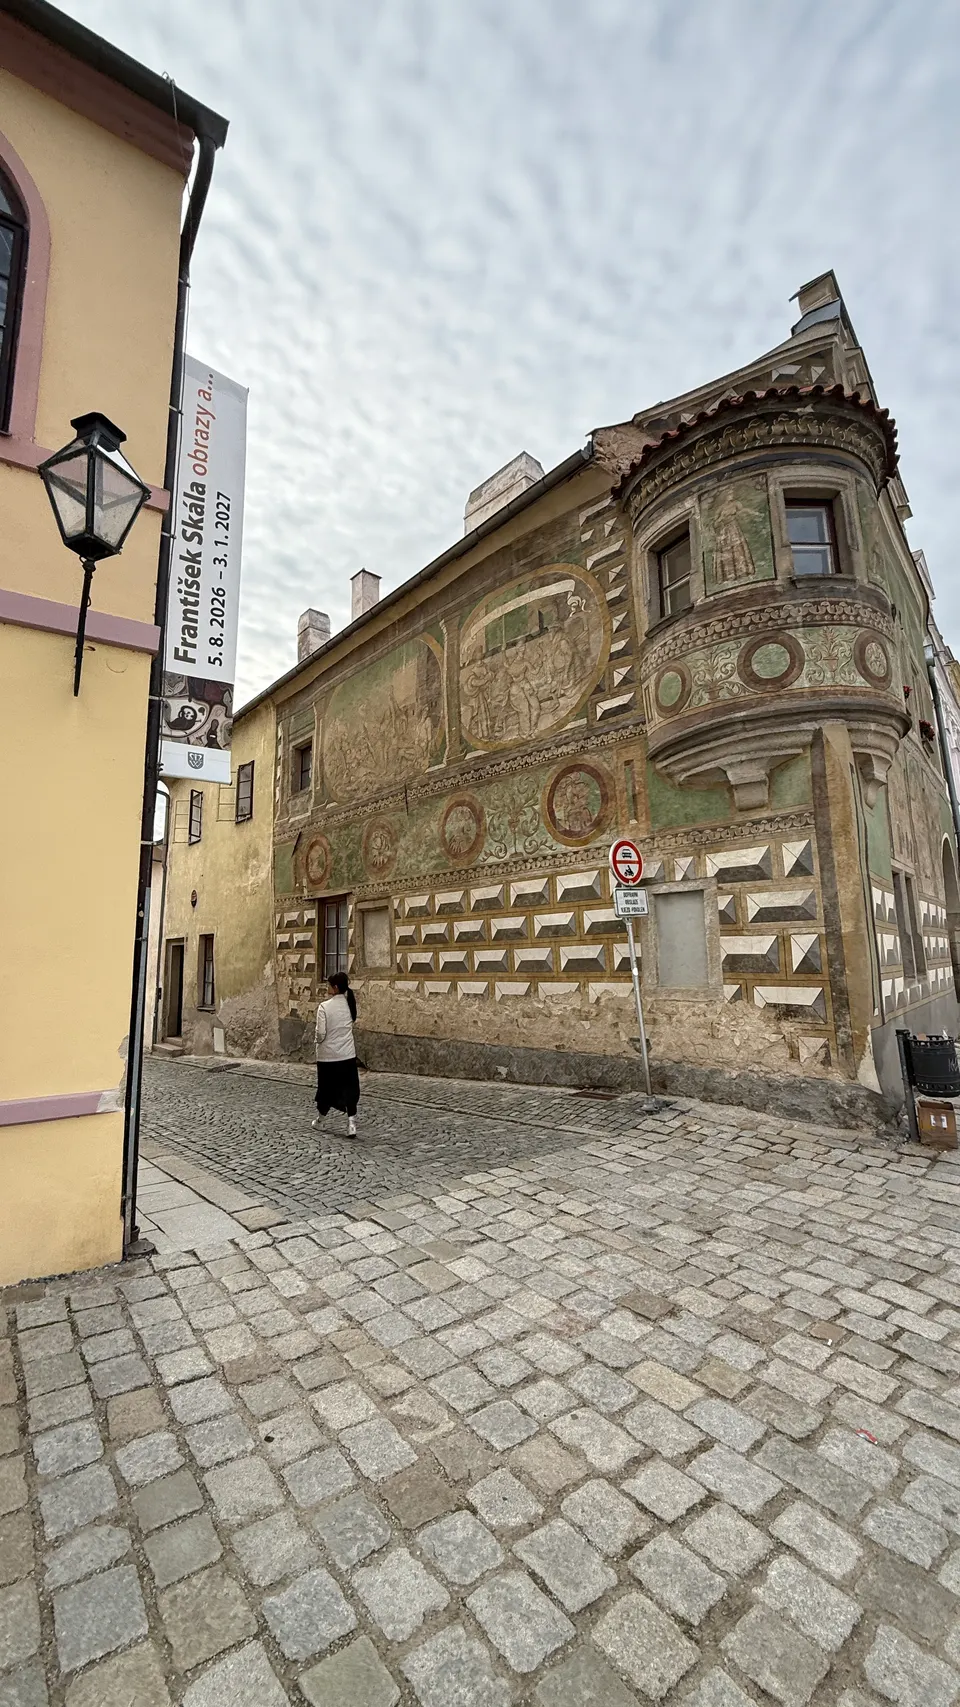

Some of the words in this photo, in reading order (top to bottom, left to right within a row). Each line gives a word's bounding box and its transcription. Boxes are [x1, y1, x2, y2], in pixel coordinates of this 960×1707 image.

[187, 403, 216, 476] obrazy
[181, 481, 206, 546] Skála
[215, 491, 231, 531] 2027
[213, 553, 228, 568] 3.
[214, 535, 229, 546] 1.
[173, 548, 202, 664] František
[209, 587, 226, 628] 2026
[208, 652, 222, 666] 5.
[209, 632, 224, 647] 8.
